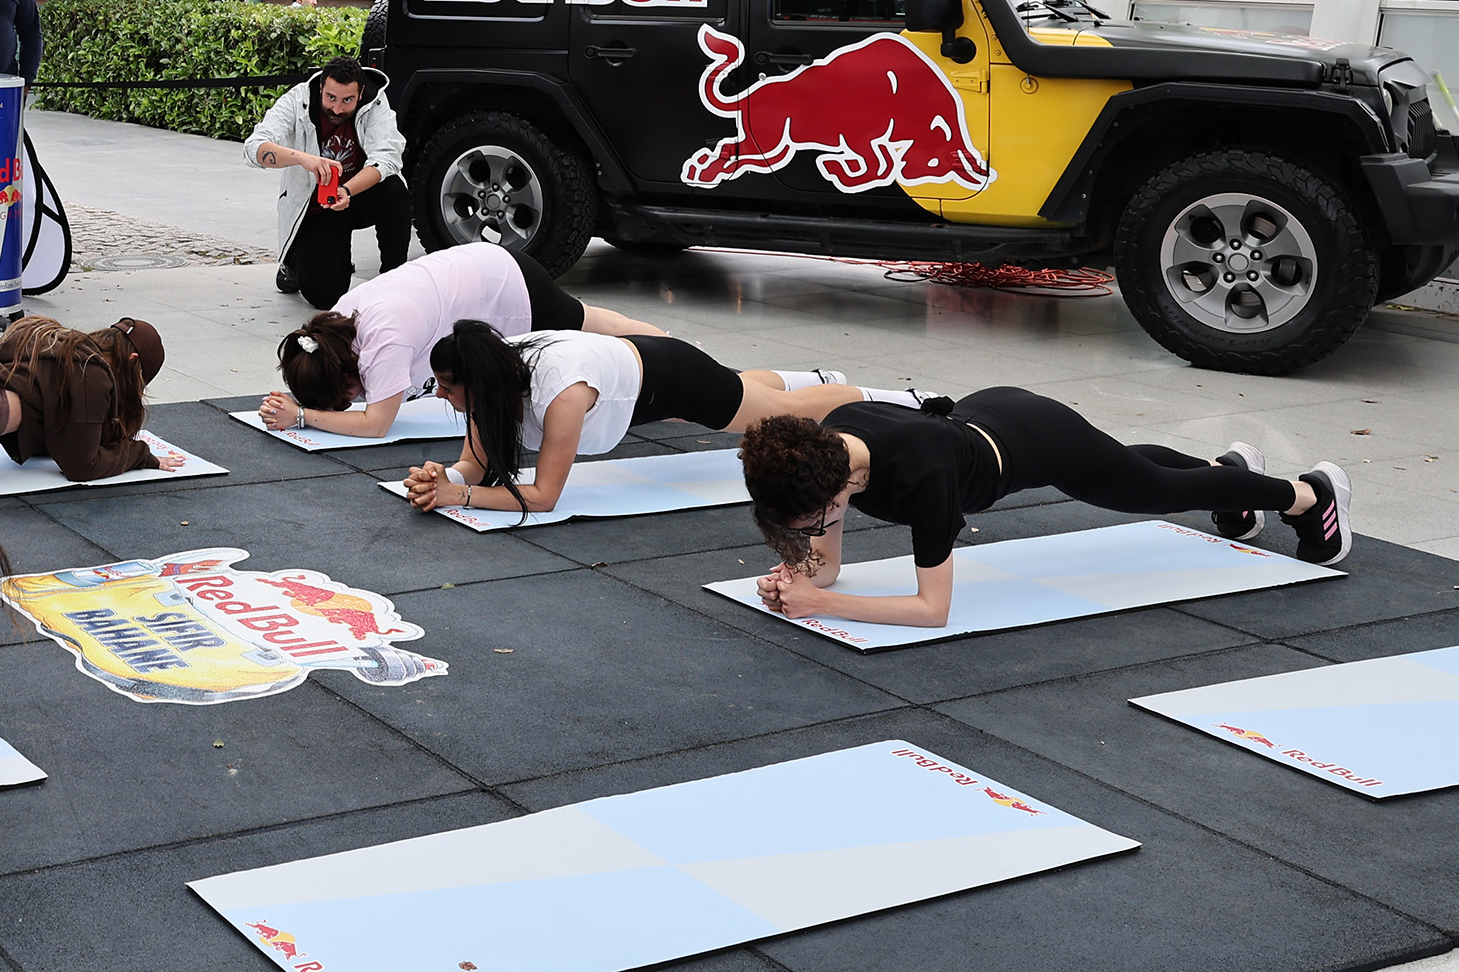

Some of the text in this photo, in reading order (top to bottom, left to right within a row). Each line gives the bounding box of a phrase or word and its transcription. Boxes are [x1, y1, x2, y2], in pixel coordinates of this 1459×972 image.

[133, 611, 229, 652] SIFIR
[176, 574, 350, 658] Red Bull
[801, 618, 869, 643] Red Bull
[60, 607, 192, 674] BAHANE
[891, 748, 980, 786] Red Bull
[1281, 749, 1383, 787] Red Bull
